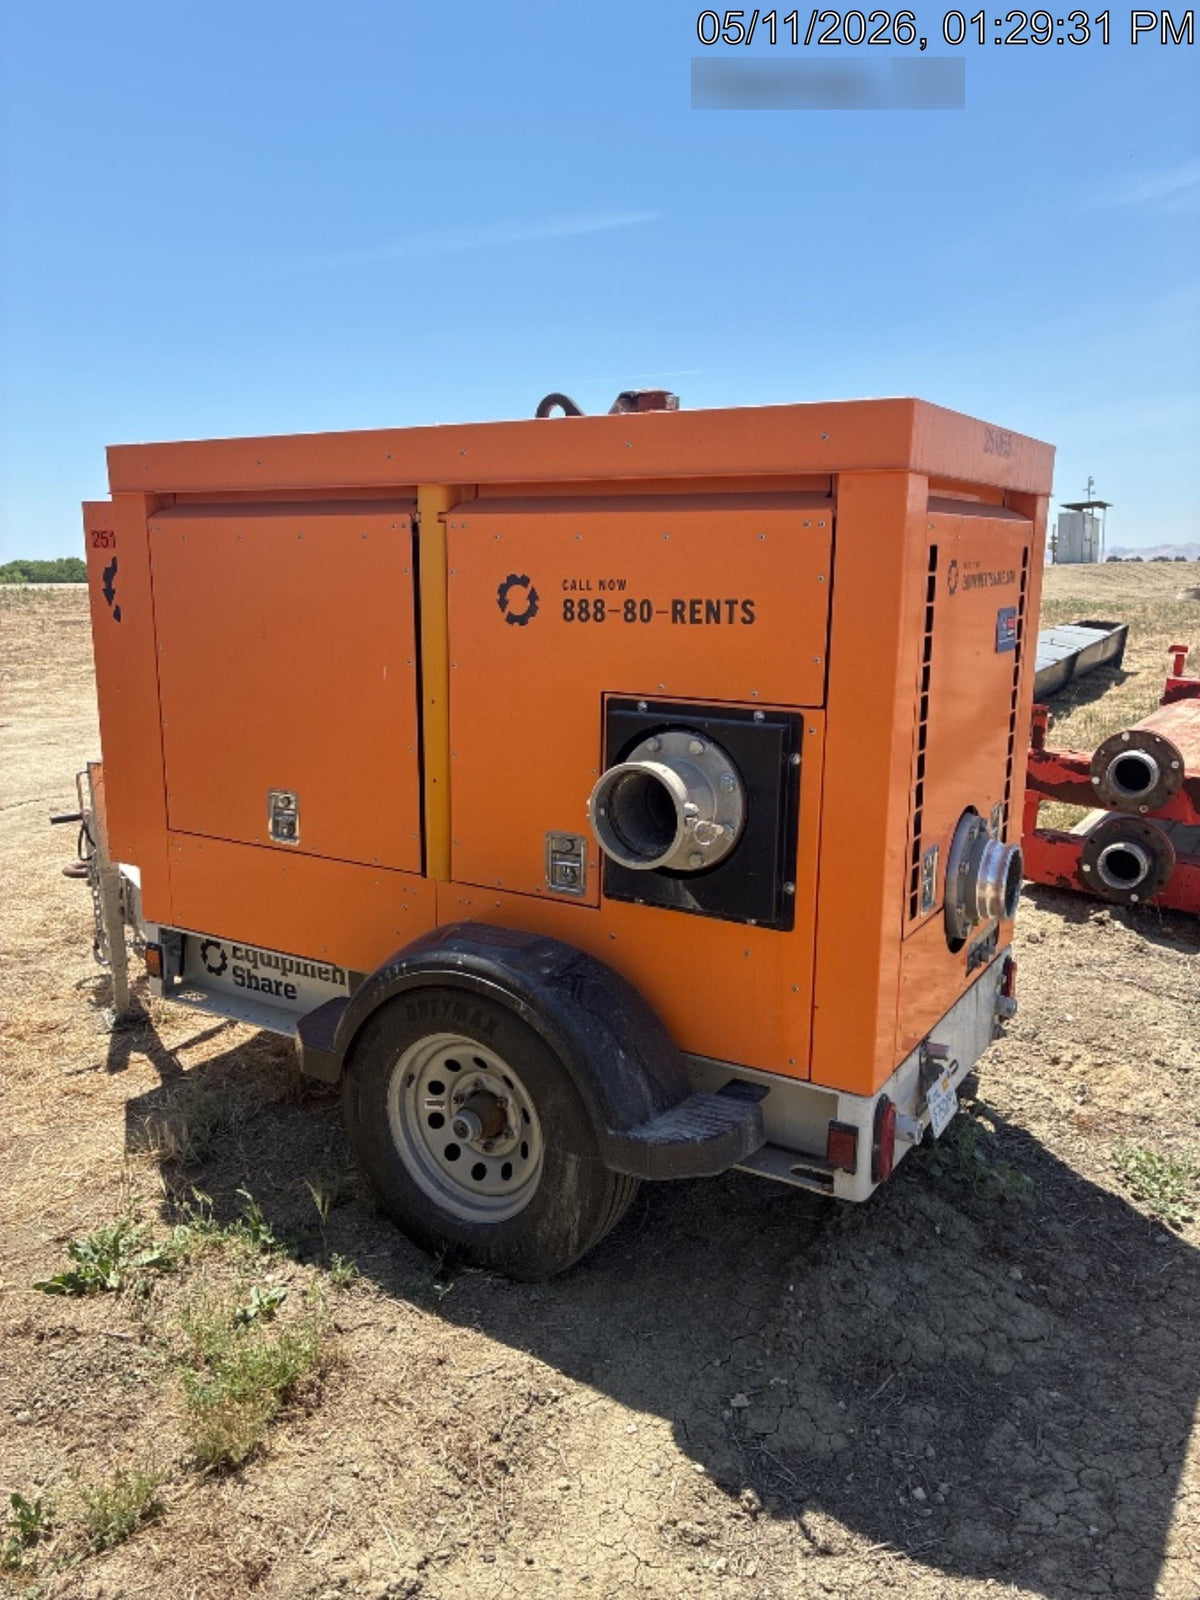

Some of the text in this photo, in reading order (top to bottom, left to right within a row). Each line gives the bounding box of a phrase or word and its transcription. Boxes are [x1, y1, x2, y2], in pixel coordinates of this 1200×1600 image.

[562, 579, 627, 591] CALL NOW
[563, 598, 755, 625] 888-80-RENTS
[232, 965, 297, 1000] Share
